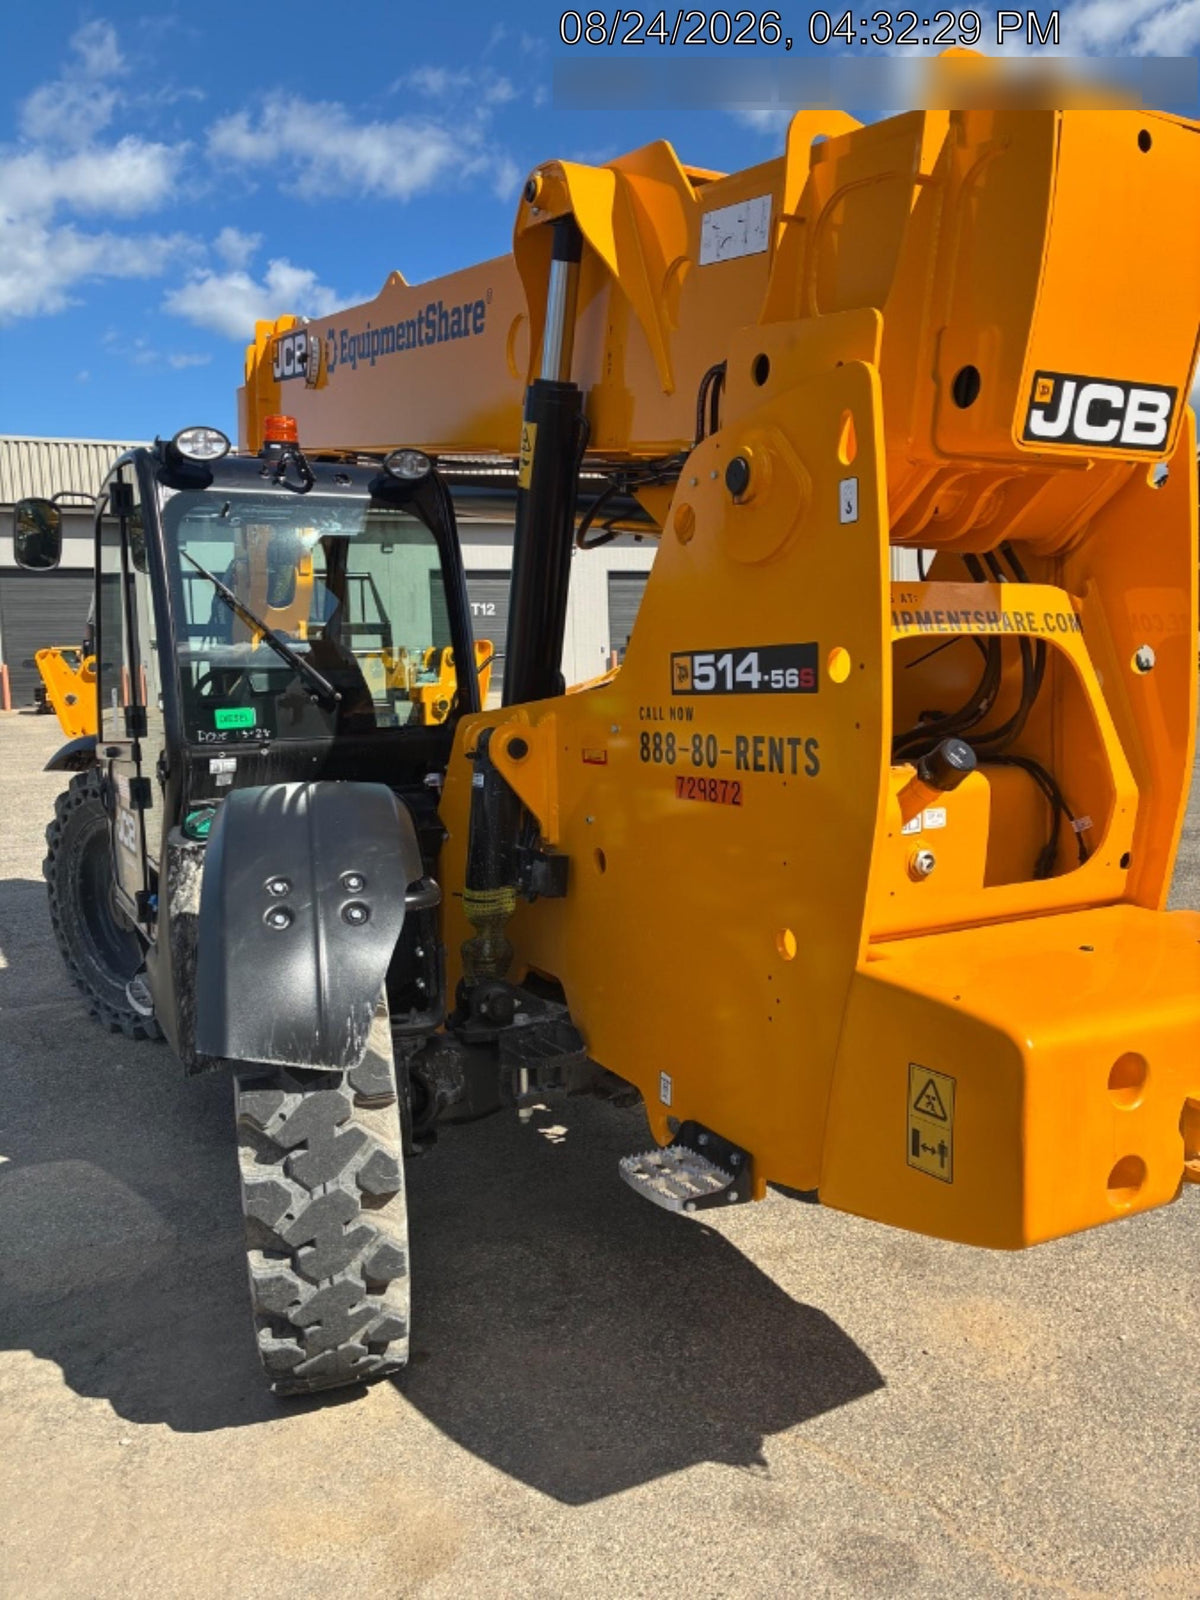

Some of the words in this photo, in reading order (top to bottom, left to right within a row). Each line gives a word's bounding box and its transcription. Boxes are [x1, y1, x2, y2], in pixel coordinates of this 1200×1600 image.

[340, 300, 486, 371] EquipmentShare
[1029, 380, 1171, 446] JCB
[471, 602, 497, 616] T12
[639, 706, 665, 721] CALL
[669, 706, 695, 722] NOW
[639, 731, 821, 778] 888-80-RENTS
[676, 776, 742, 806] 729872
